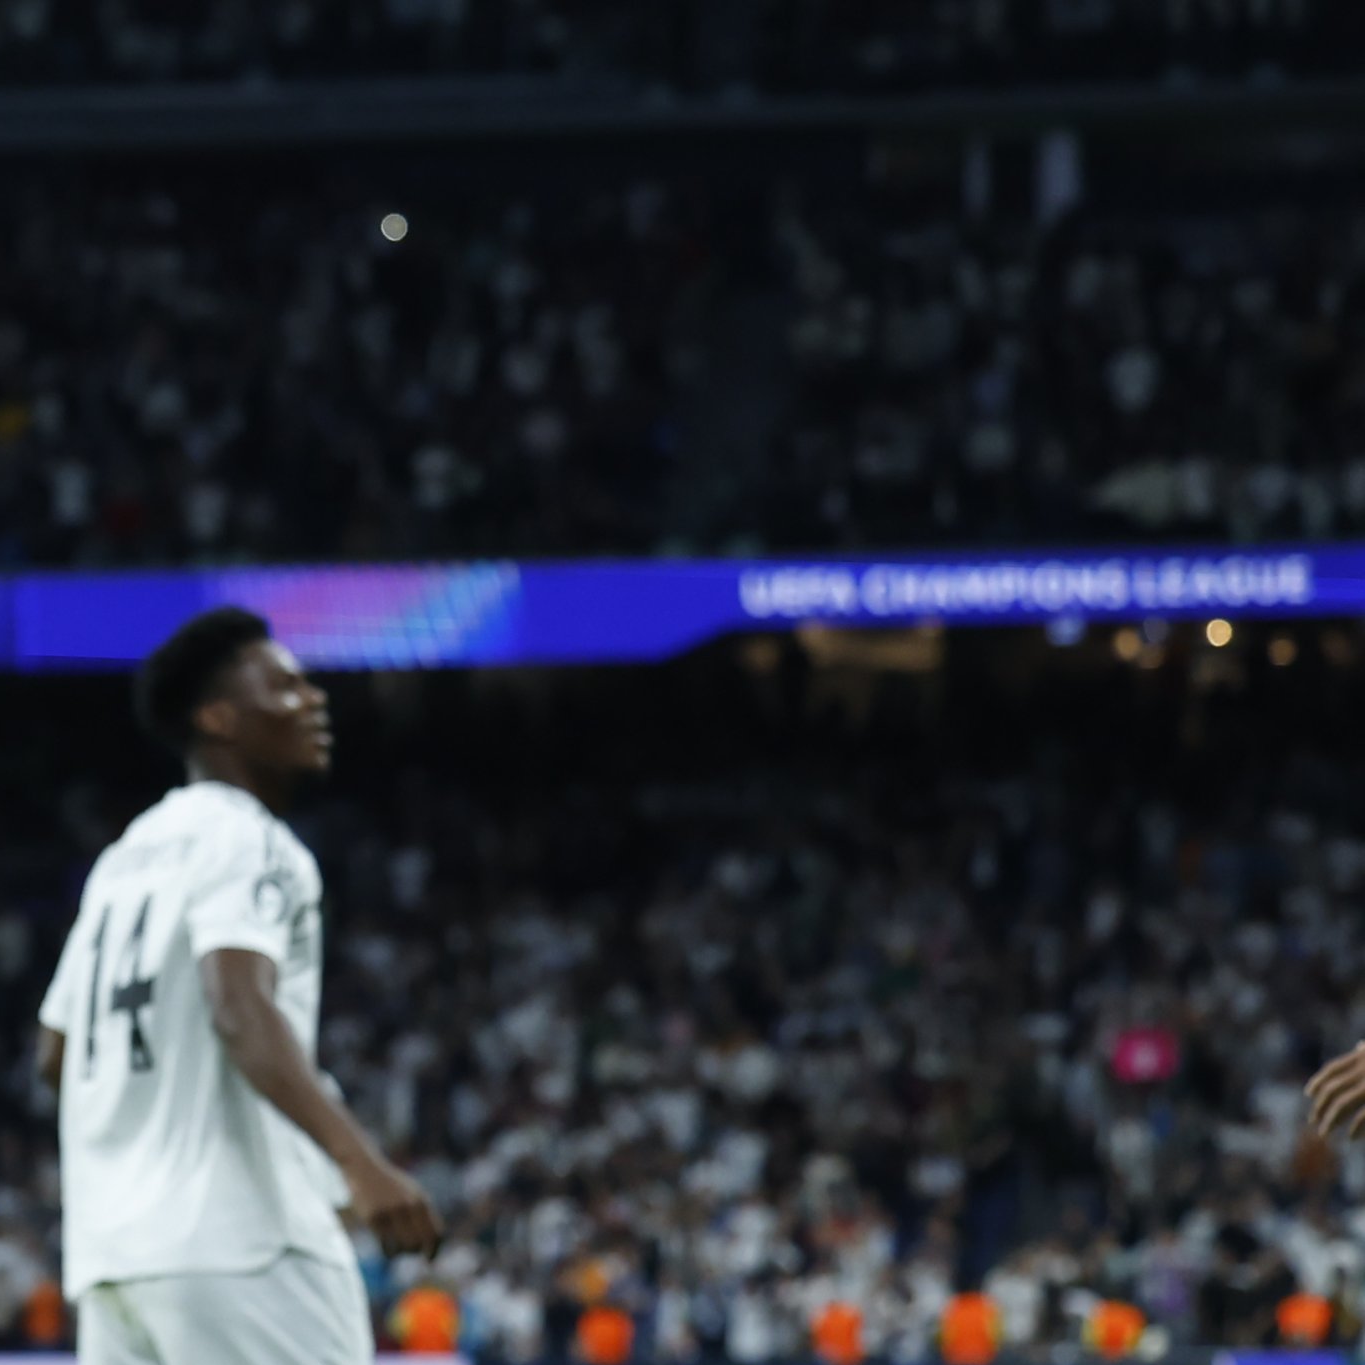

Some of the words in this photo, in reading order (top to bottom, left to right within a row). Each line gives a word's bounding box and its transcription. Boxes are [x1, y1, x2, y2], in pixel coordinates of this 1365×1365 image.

[739, 566, 857, 617] UEFA
[860, 560, 1128, 614] CHAMPIONS
[1134, 554, 1311, 608] LEAGUE
[81, 892, 157, 1080] 14
